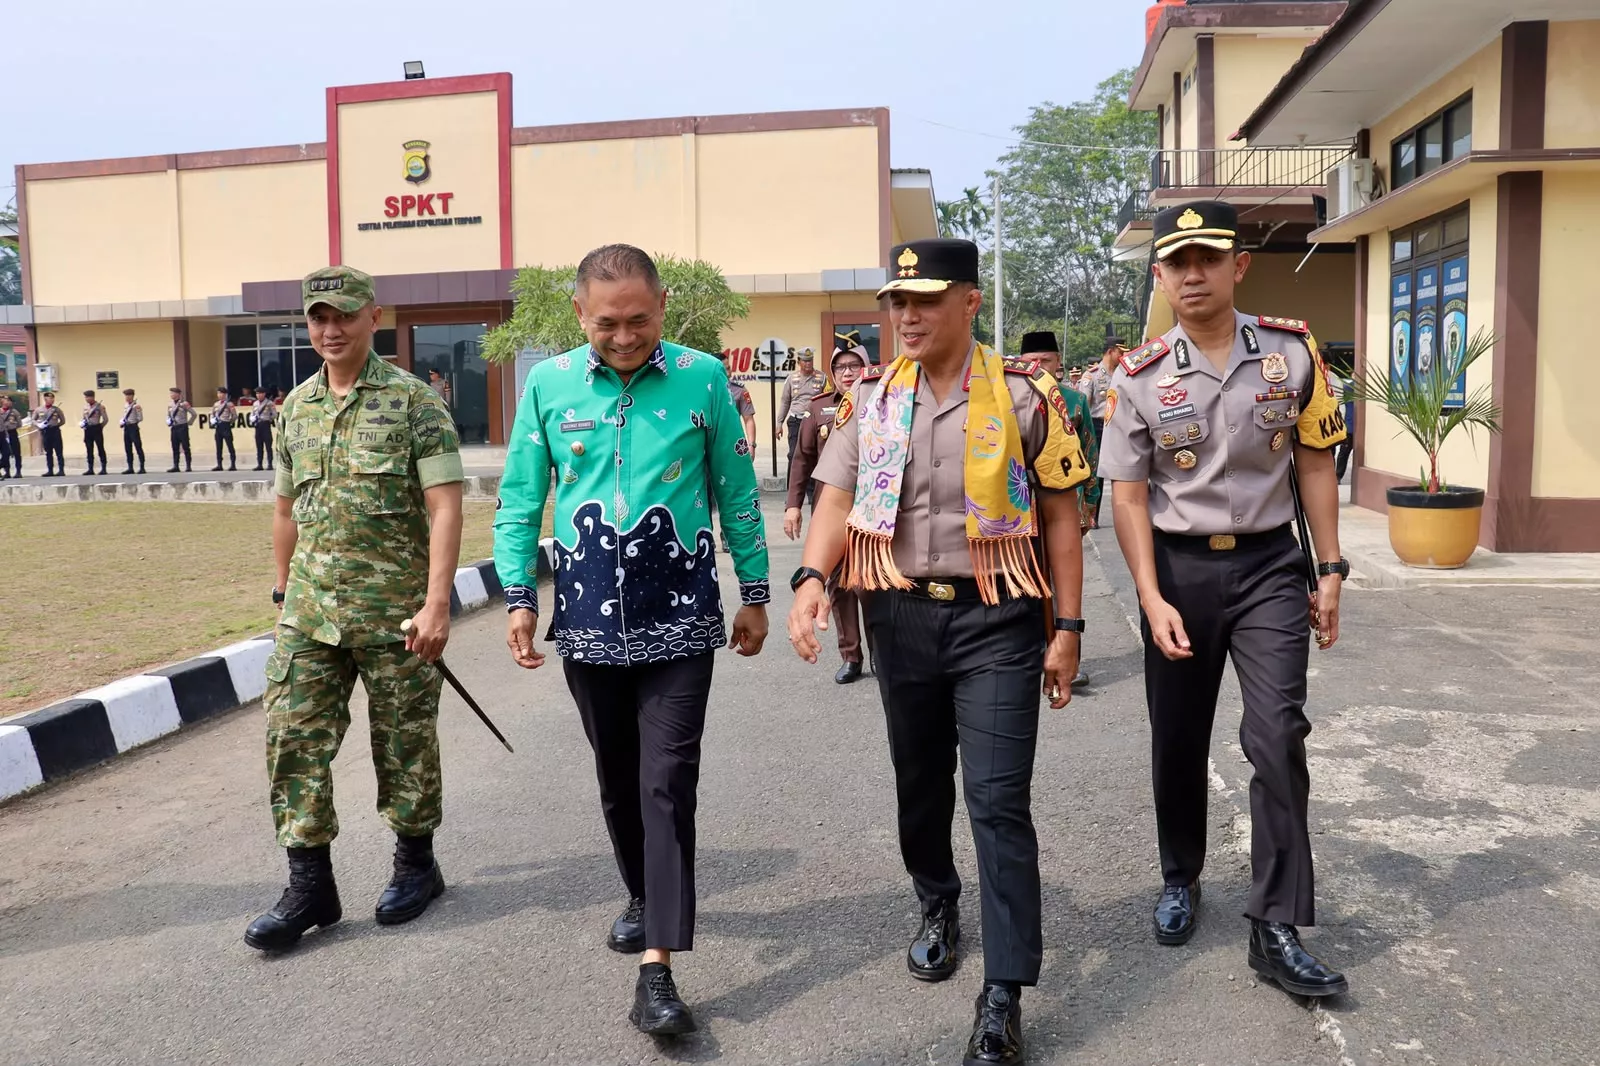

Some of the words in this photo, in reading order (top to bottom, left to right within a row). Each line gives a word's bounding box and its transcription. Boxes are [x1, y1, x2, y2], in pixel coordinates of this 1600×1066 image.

[384, 192, 454, 218] SPKT
[307, 437, 319, 448] EDI
[357, 431, 377, 442] TNI
[385, 433, 404, 444] AD
